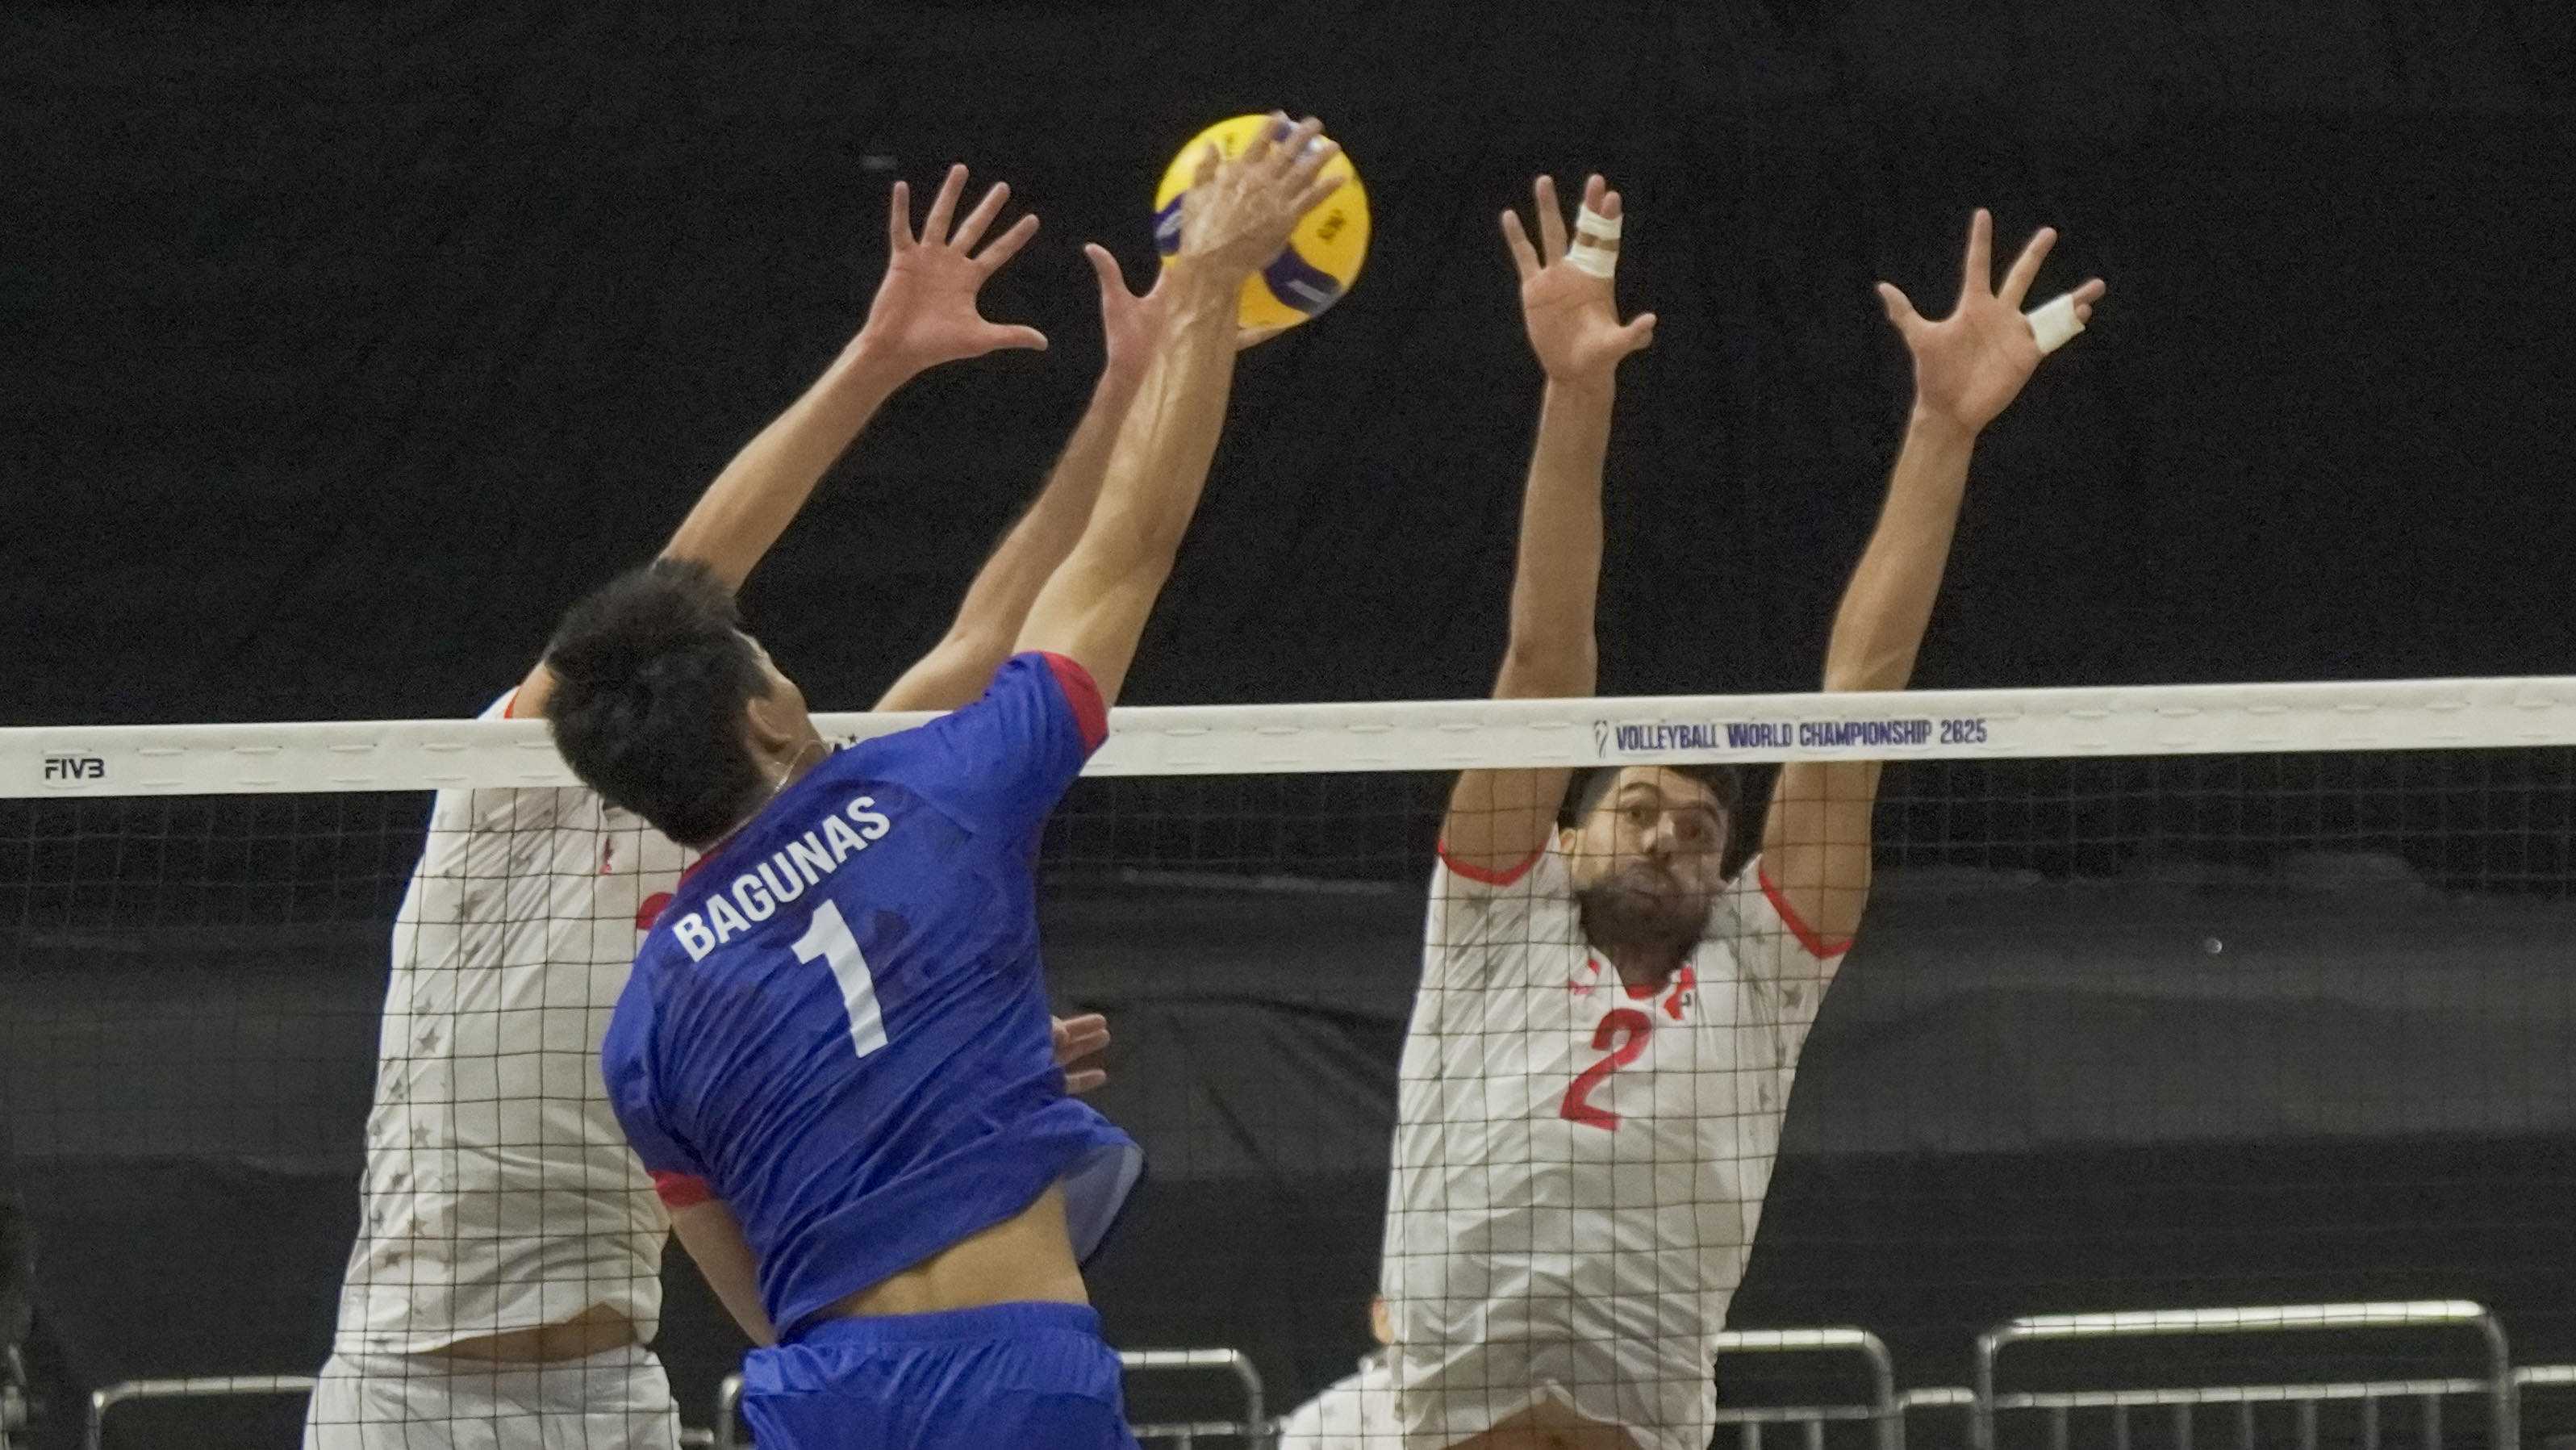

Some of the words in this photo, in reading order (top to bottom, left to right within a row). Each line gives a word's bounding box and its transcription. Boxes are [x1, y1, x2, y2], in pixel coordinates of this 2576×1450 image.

[45, 758, 105, 779] FIVB
[1616, 723, 1718, 750] VOLLEYBALL
[1726, 722, 1793, 748] WORLD
[1799, 719, 1933, 746] CHAMPIONSHIP
[1939, 717, 1988, 744] 2025
[672, 796, 891, 963] BAGUNAS
[791, 898, 889, 1059] 1
[1559, 1008, 1653, 1131] 2
